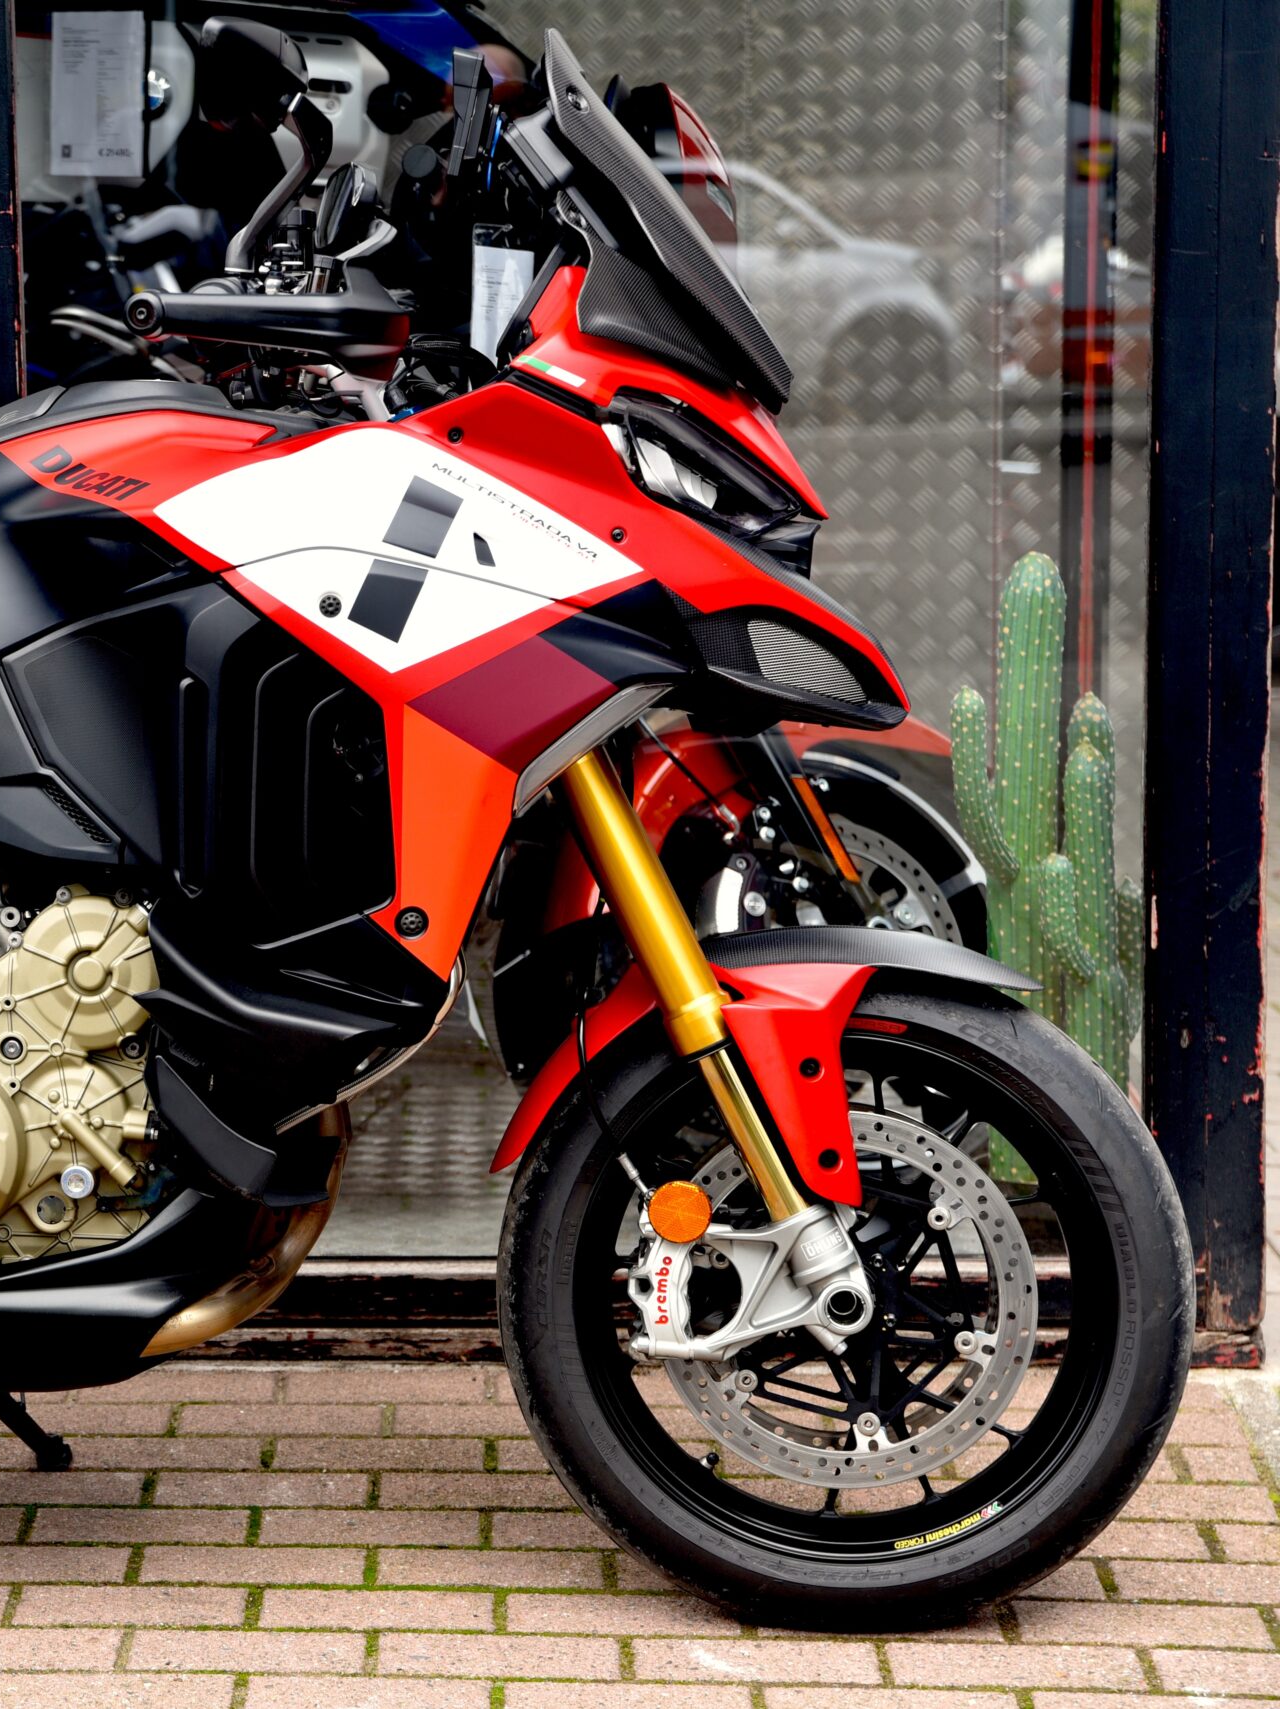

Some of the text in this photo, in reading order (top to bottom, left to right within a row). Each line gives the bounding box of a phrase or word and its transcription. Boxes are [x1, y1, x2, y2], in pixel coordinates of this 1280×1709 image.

[31, 444, 151, 501] DUCATI
[432, 462, 572, 543] MULTISTRADA
[577, 542, 598, 559] V4
[805, 1231, 843, 1257] ÖHLINS
[655, 1256, 673, 1325] brembo
[894, 1513, 981, 1549] marchesini FORGED
